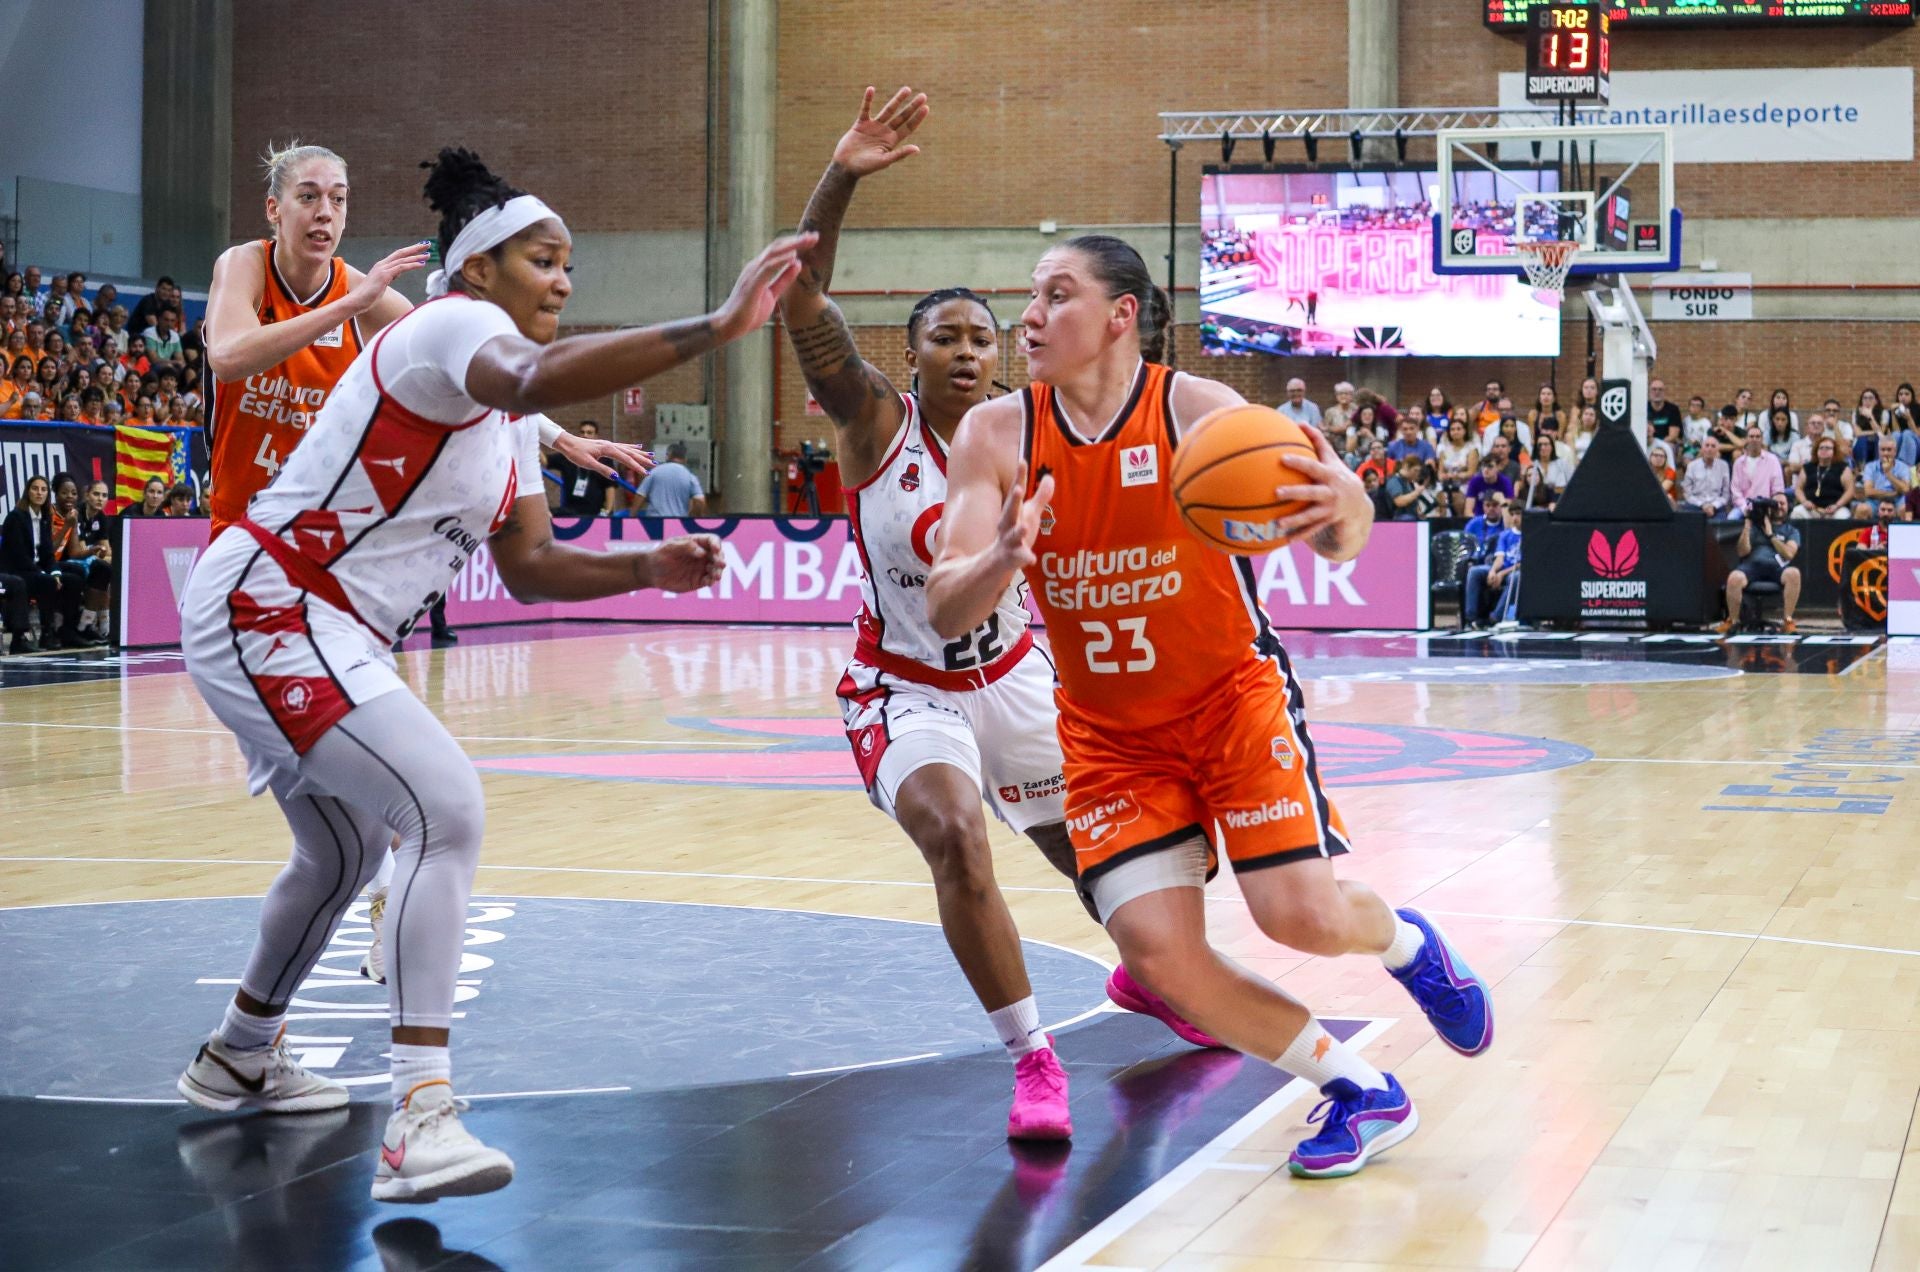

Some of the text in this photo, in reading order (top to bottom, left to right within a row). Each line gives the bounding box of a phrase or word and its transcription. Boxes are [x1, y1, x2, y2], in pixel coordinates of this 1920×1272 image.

[1552, 9, 1588, 28] 7:02
[1548, 32, 1589, 68] 13
[1529, 76, 1595, 95] SUPERCOPA
[1669, 287, 1734, 301] FONDO
[1685, 303, 1718, 317] SUR
[245, 372, 325, 406] Cultura
[239, 392, 317, 430] Esfuer
[253, 433, 279, 476] 4
[1041, 545, 1176, 579] Cultura del
[887, 567, 927, 588] Cas
[1045, 571, 1182, 610] Esfuerzo
[1581, 581, 1646, 599] SUPERCOPA
[944, 612, 1003, 670] 22
[1080, 617, 1156, 674] 23
[1023, 773, 1065, 790] Zarago
[1025, 783, 1067, 799] DEPOR
